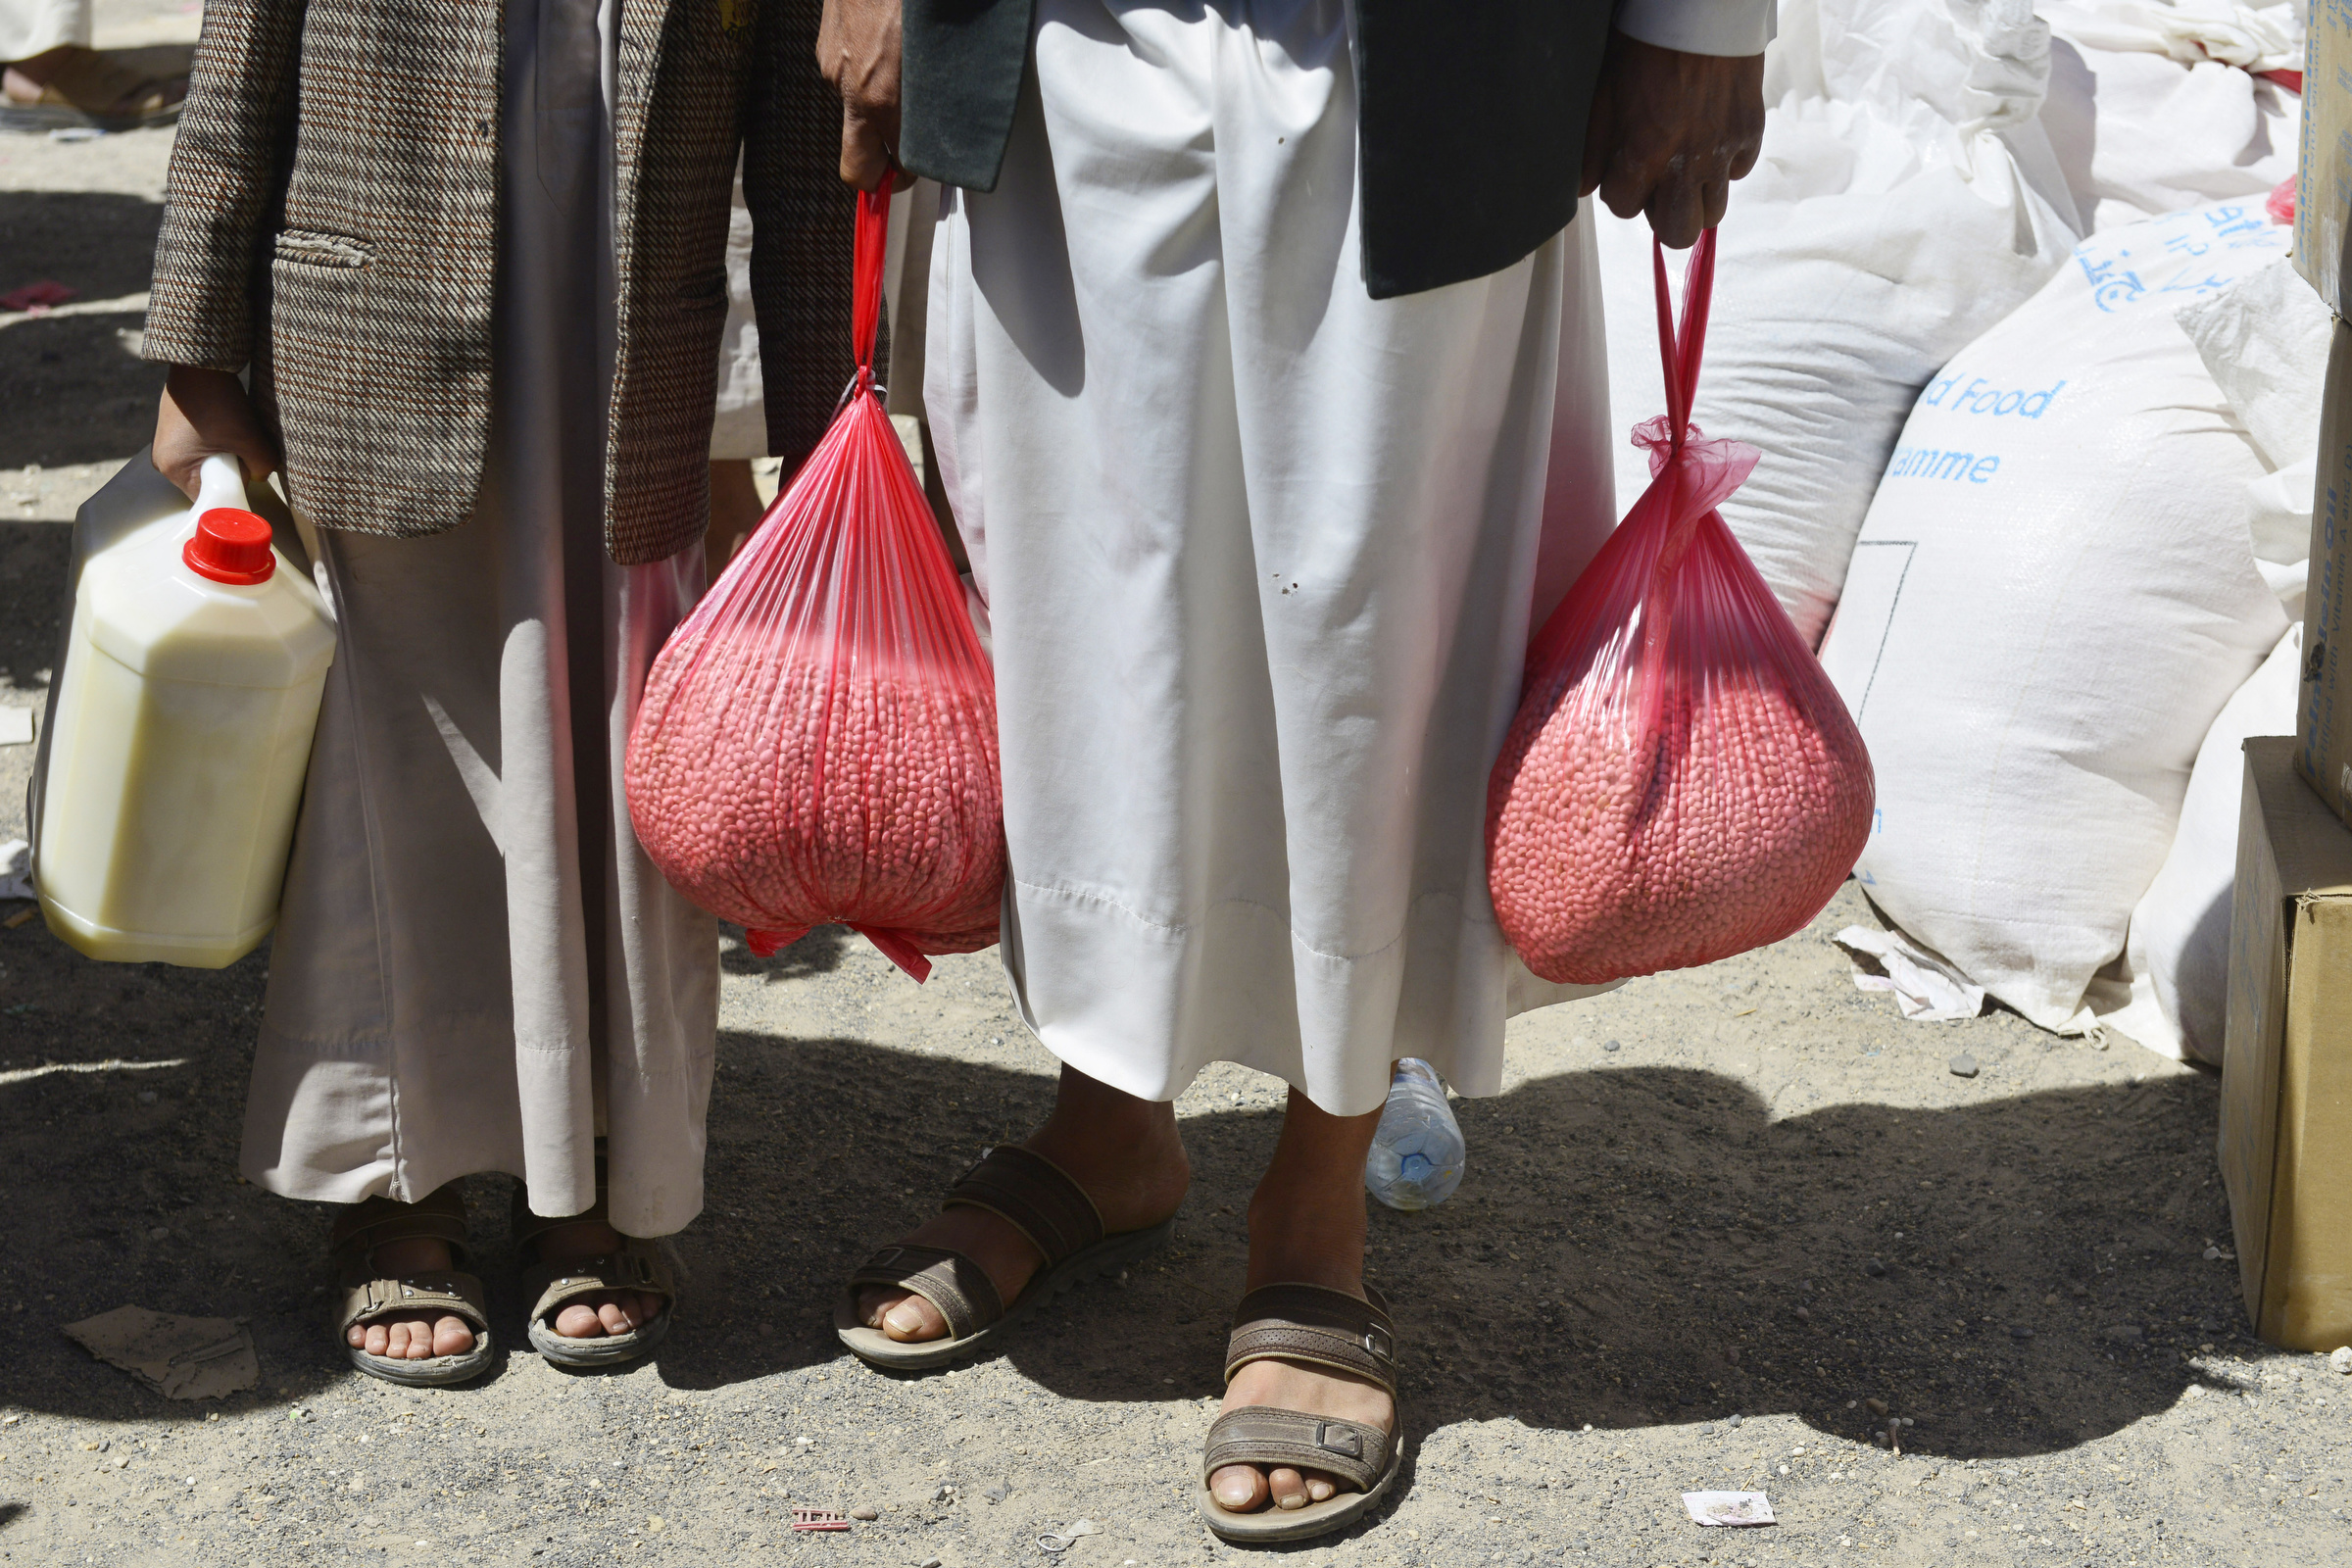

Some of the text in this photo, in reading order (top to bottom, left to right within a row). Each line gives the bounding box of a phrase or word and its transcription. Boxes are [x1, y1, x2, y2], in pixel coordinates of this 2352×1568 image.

[1950, 377, 2068, 419] Food
[2325, 486, 2337, 550] Oil
[2342, 479, 2351, 521] and
[2339, 528, 2348, 543] A
[2332, 553, 2346, 632] Vitamin
[2328, 645, 2339, 690] with
